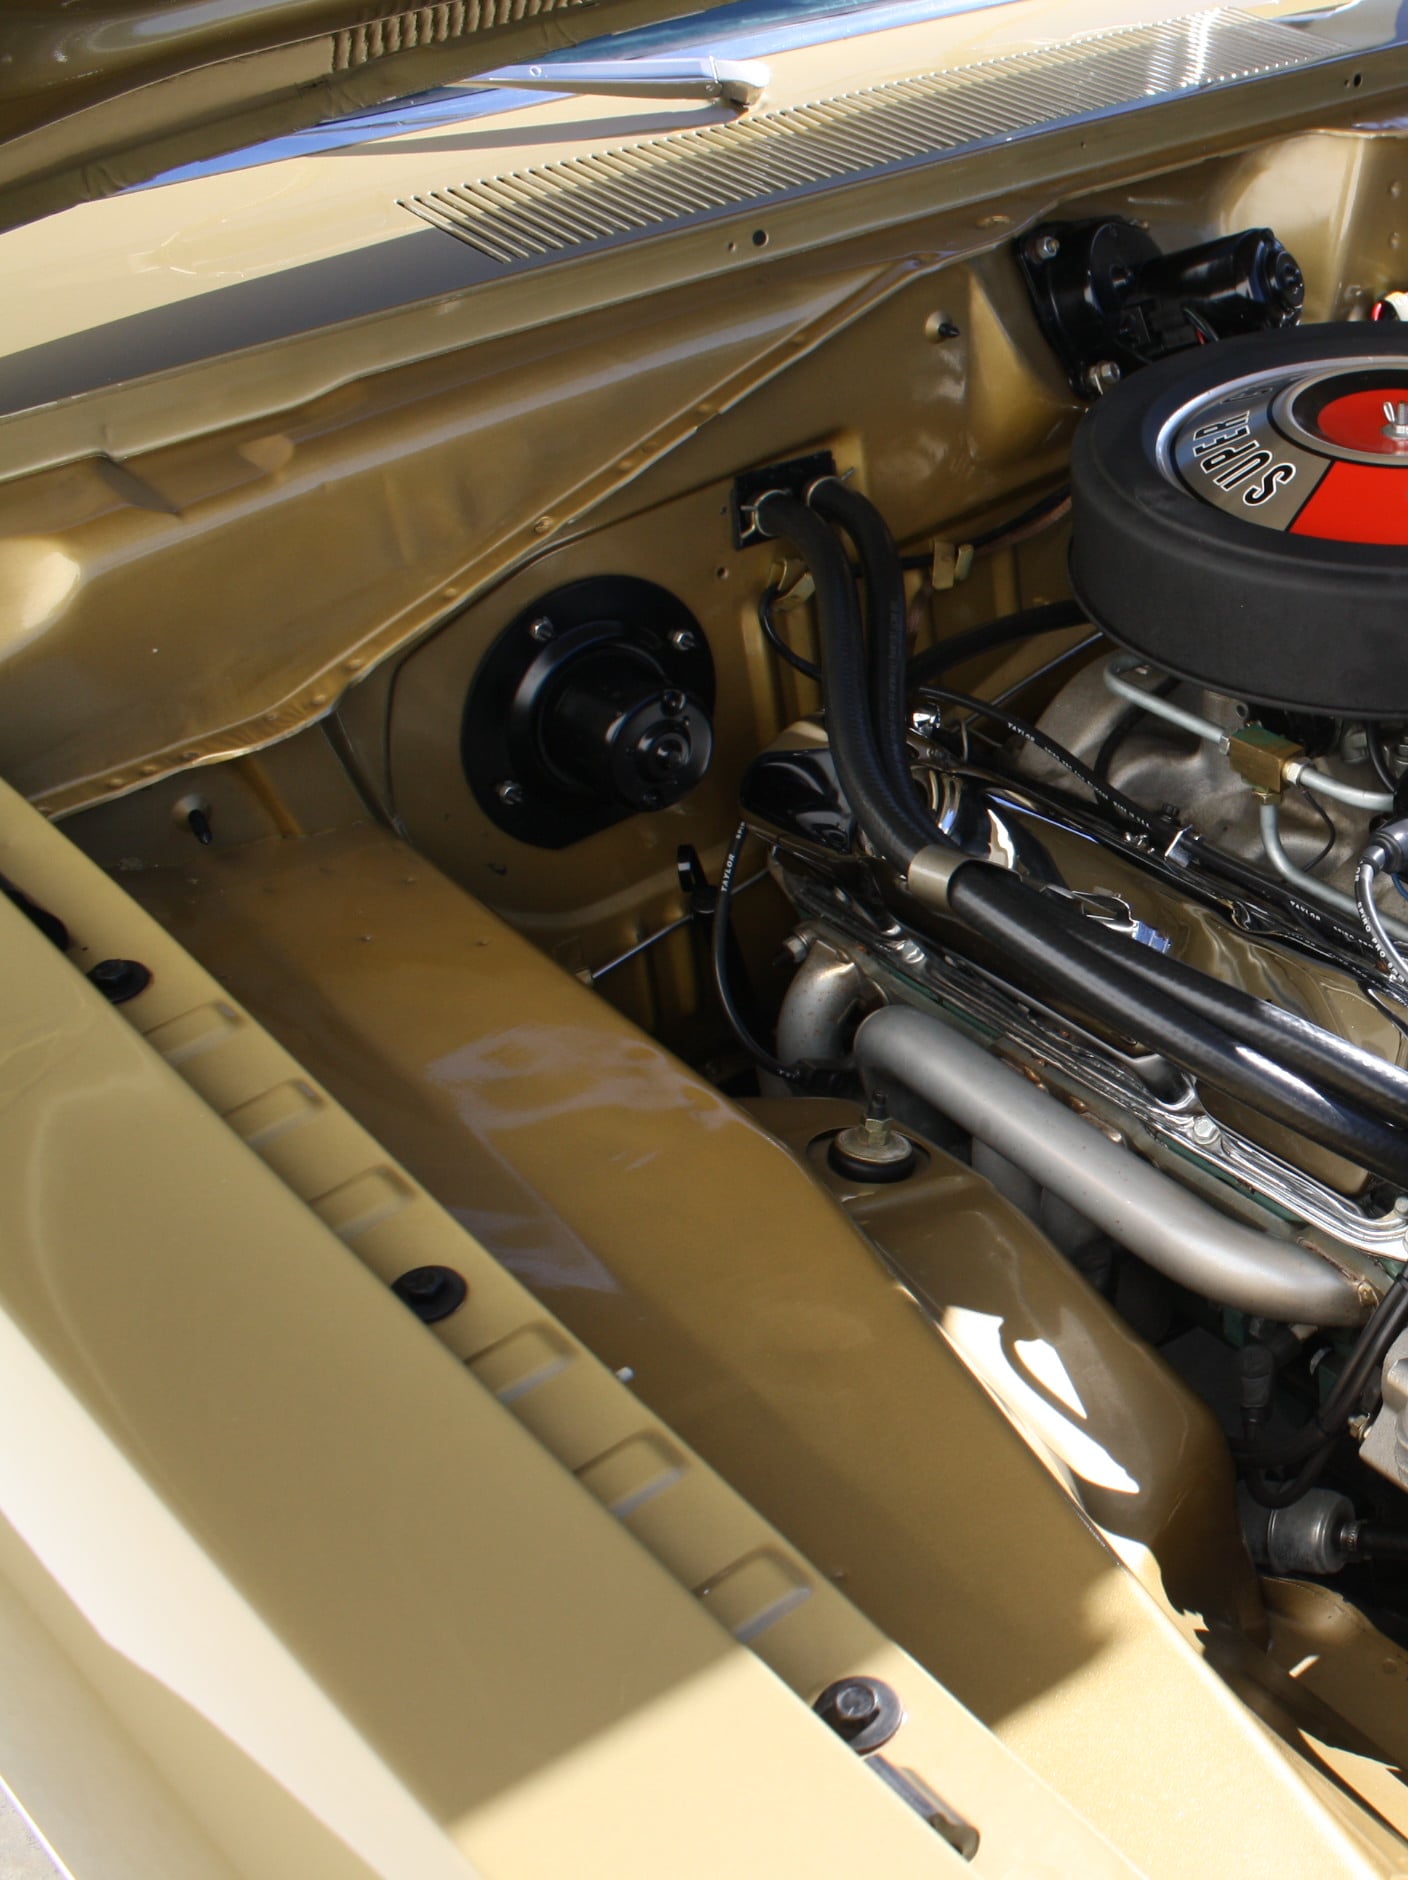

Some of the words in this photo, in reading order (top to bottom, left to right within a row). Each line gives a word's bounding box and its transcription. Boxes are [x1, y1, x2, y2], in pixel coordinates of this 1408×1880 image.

[1192, 410, 1297, 506] SUPER
[720, 853, 736, 892] TAYLOR
[1357, 901, 1372, 933] SPIRO
[1371, 937, 1387, 958] PRO
